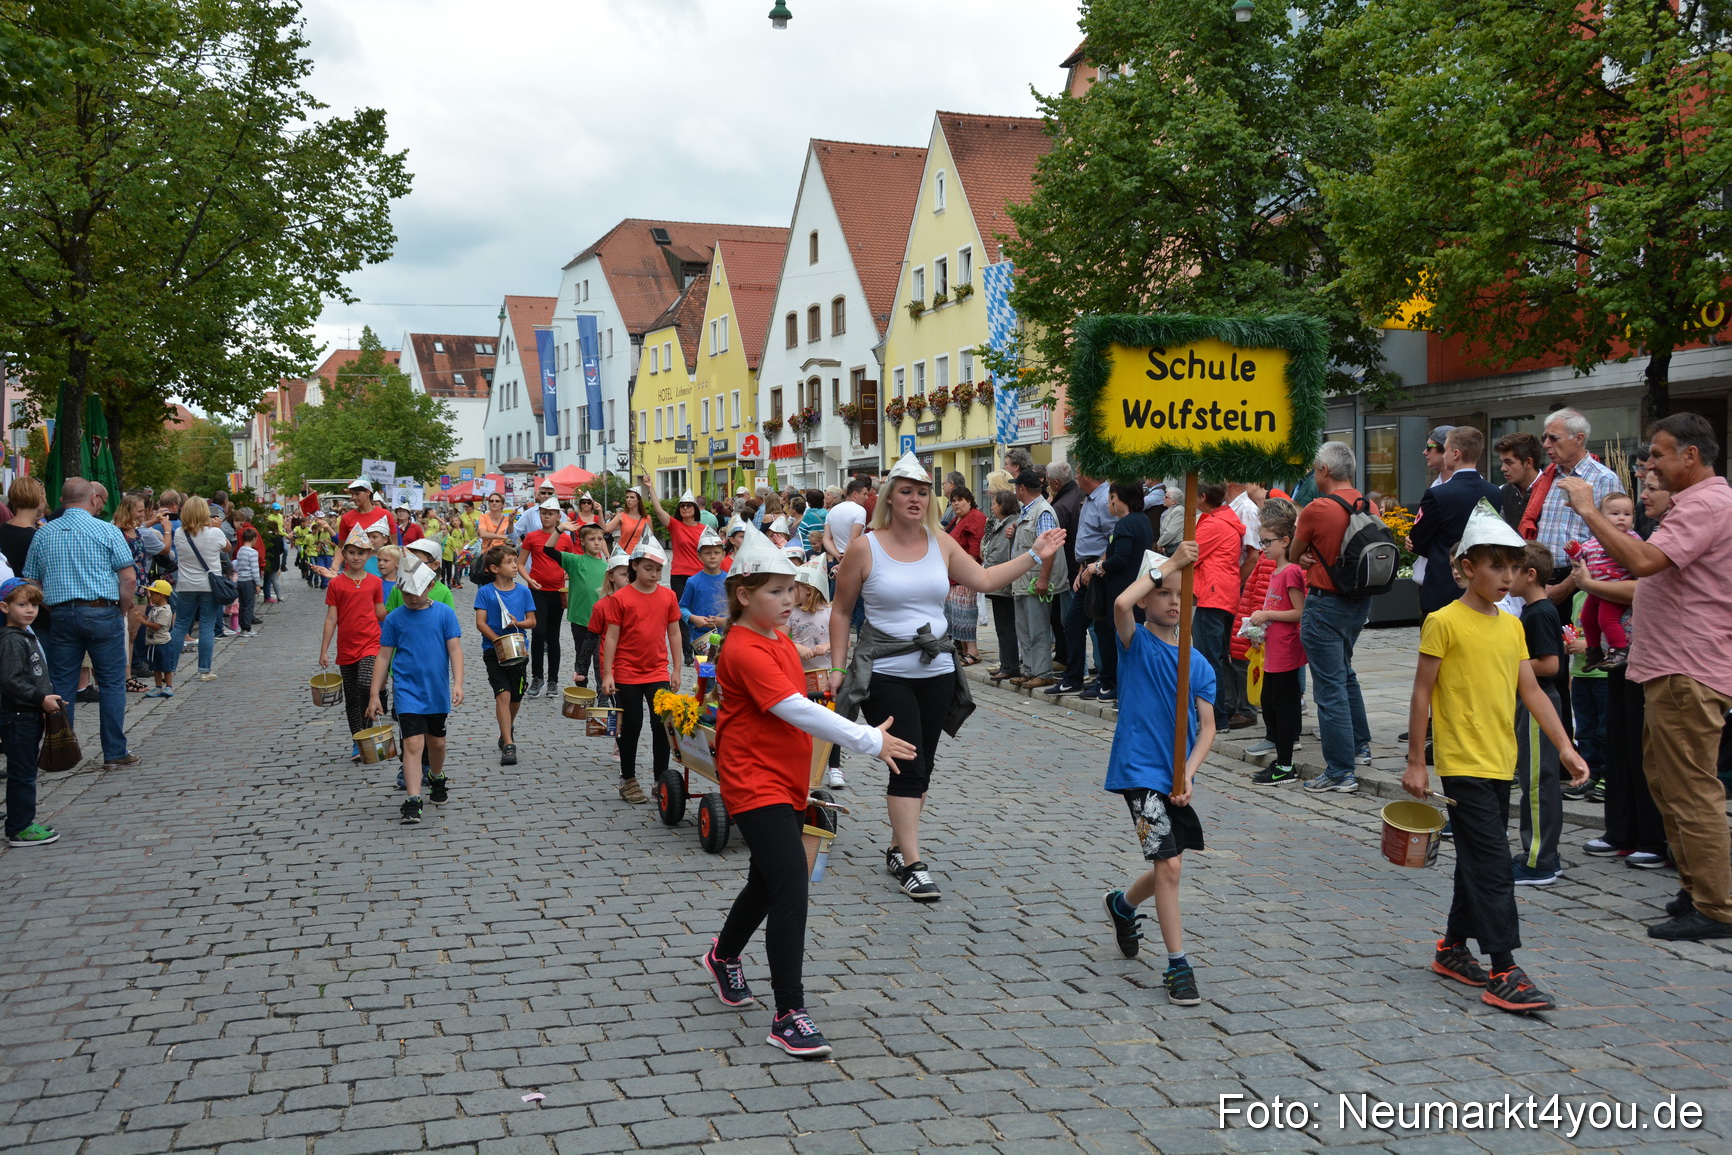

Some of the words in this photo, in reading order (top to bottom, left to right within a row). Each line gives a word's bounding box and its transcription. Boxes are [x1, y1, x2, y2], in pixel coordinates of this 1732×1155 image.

[1145, 347, 1257, 382] Schule
[658, 387, 672, 402] HOTEL
[1122, 398, 1277, 433] Wolfstein
[904, 438, 912, 450] P
